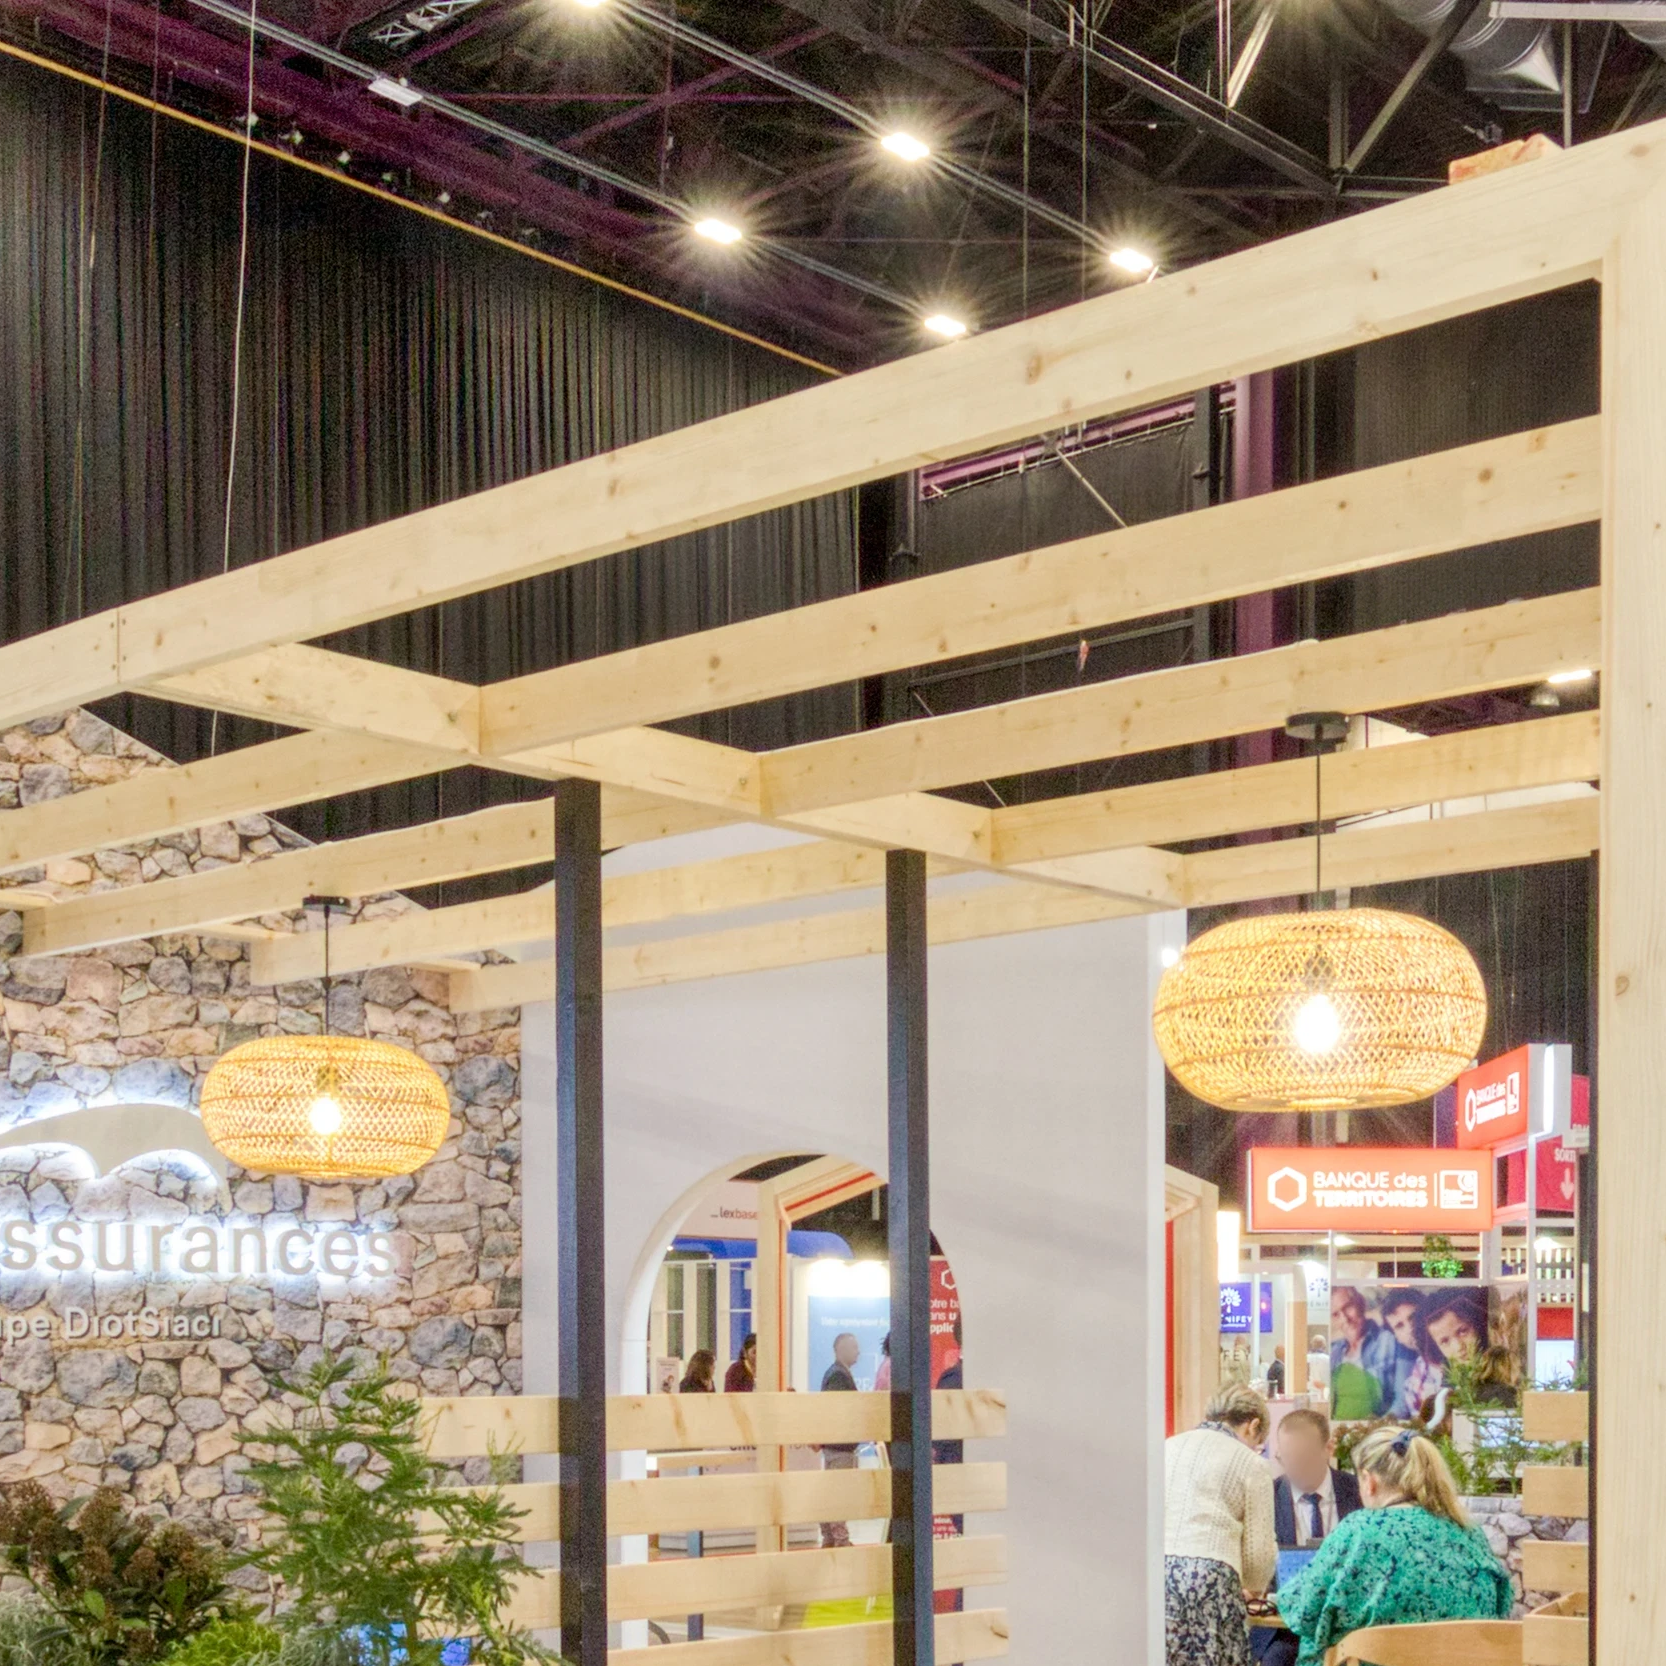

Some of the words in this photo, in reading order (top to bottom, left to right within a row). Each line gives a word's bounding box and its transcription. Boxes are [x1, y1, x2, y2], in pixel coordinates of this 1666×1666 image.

[1313, 1171, 1390, 1188] BANQUE
[1393, 1172, 1428, 1188] des
[64, 1306, 221, 1339] DiotSiaci
